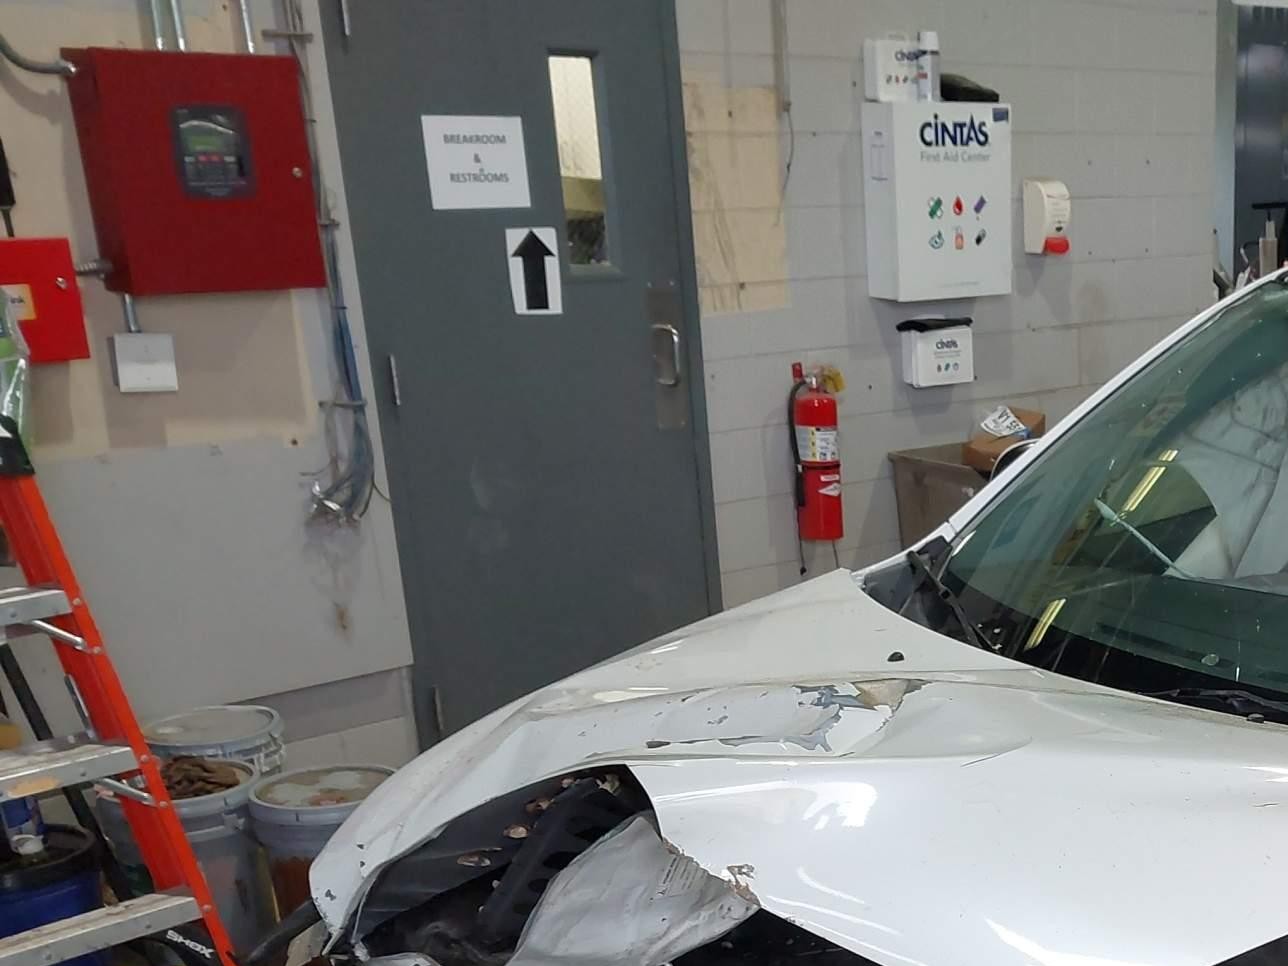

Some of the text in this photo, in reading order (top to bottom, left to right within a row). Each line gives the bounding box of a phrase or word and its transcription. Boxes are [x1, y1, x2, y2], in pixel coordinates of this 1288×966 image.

[920, 113, 990, 147] CINTAS
[443, 134, 507, 144] BREAKROOM
[473, 153, 481, 163] &
[920, 151, 991, 162] First Aid Center
[450, 173, 509, 183] RESTROOMS
